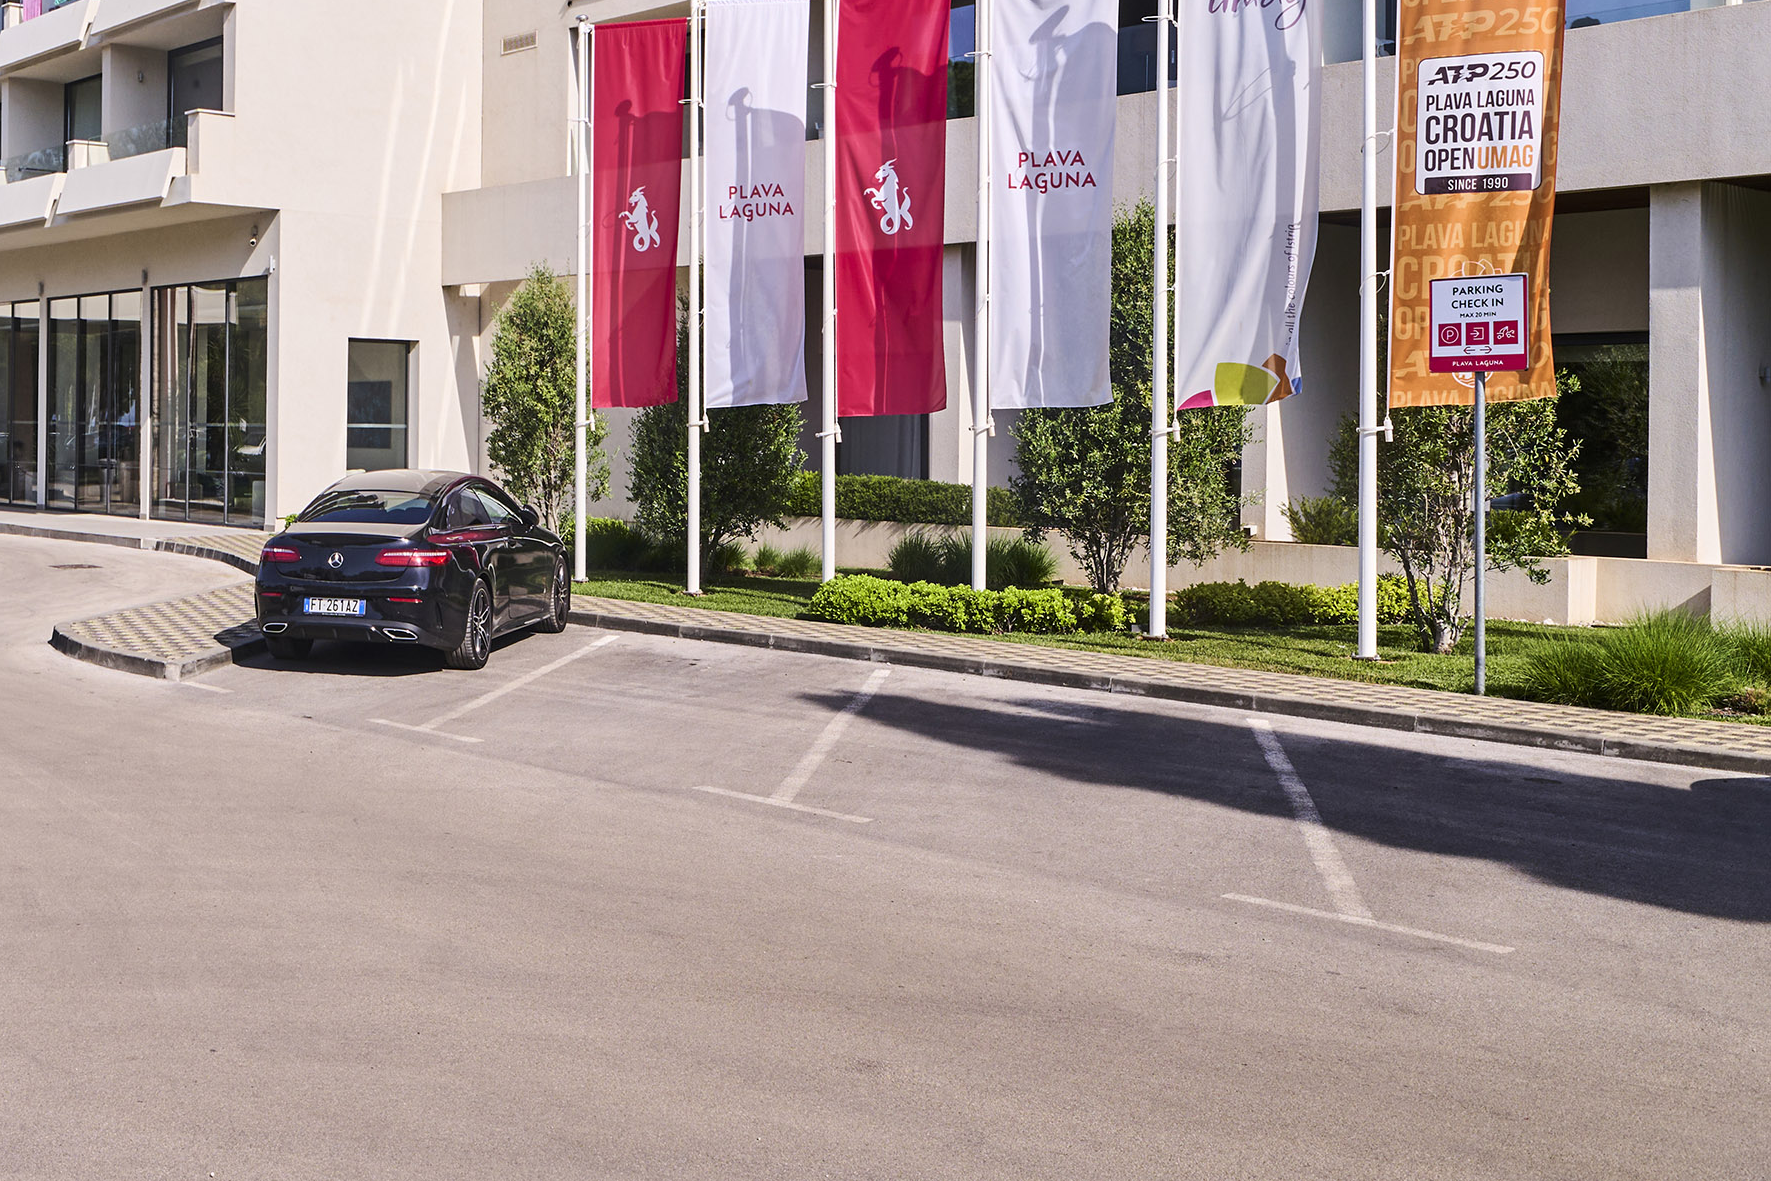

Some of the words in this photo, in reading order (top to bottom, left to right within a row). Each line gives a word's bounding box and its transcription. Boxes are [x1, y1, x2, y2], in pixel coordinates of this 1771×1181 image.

[1426, 91, 1473, 111] PLAVA
[1477, 88, 1535, 108] LAGUNA
[1425, 110, 1534, 144] CROATIA
[1018, 150, 1085, 168] PLAVA
[728, 183, 785, 200] PLAVA
[1008, 171, 1097, 194] LAGUNA
[1447, 178, 1477, 191] SINCE
[1482, 176, 1509, 189] 1990
[719, 202, 794, 222] LAGUNA
[1397, 222, 1465, 250] PLAVA
[1284, 250, 1295, 262] of
[1284, 265, 1296, 299] colours
[1452, 284, 1504, 296] PARKING
[1284, 302, 1296, 318] the
[1451, 298, 1489, 309] CHECK
[1491, 297, 1504, 307] IN
